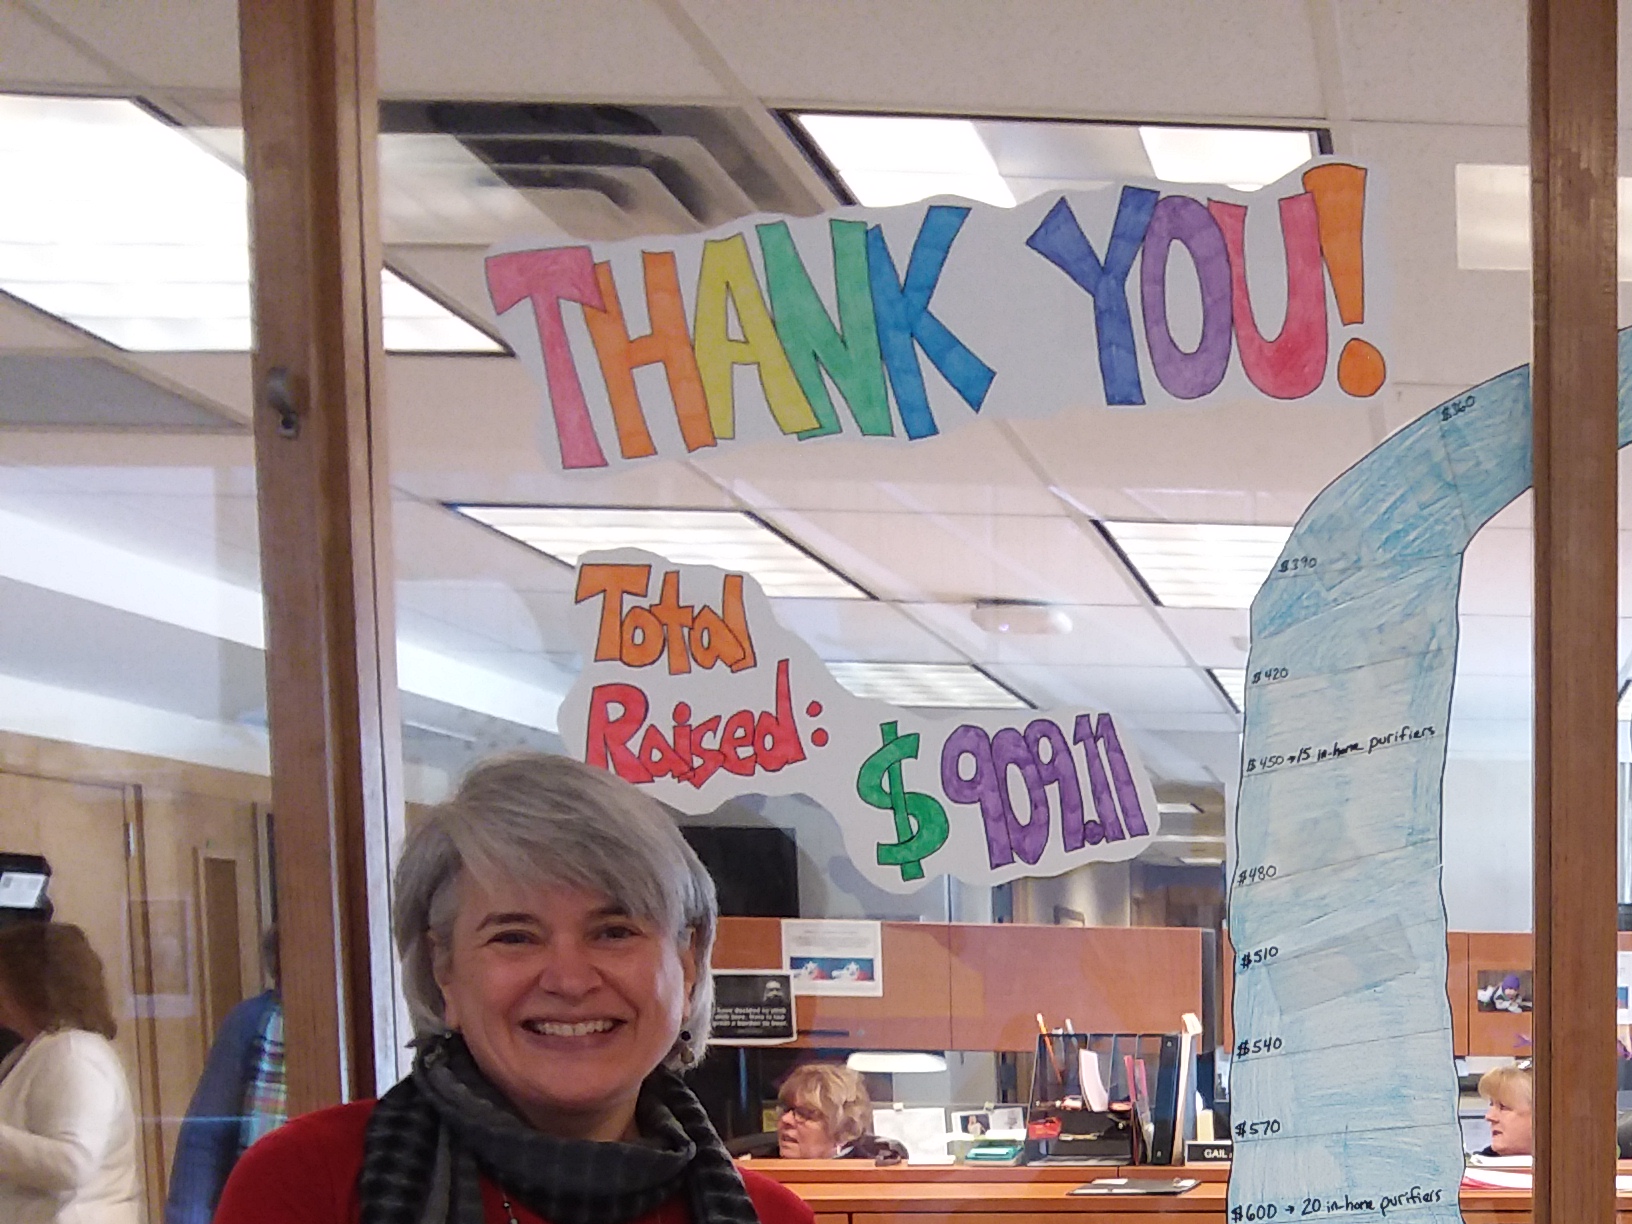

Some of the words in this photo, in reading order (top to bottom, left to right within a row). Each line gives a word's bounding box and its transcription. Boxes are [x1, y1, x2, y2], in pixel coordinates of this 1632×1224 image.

[484, 206, 995, 469] THANK
[1025, 164, 1385, 406] YOU!
[1441, 396, 1475, 421] $360
[1278, 557, 1317, 573] $390
[576, 564, 756, 675] Total
[1252, 667, 1288, 684] $420
[586, 658, 828, 789] Raised:
[1247, 755, 1284, 772] $450
[1369, 725, 1436, 754] purifiers
[1238, 865, 1277, 885] $480
[1241, 946, 1278, 969] $510
[1236, 1037, 1282, 1059] $540
[1235, 1119, 1280, 1137] $570
[1204, 1149, 1228, 1158] GAIL
[1231, 1204, 1277, 1222] $600
[1301, 1198, 1321, 1216] 20
[1326, 1195, 1375, 1213] in-home
[1380, 1186, 1442, 1217] purifiers
